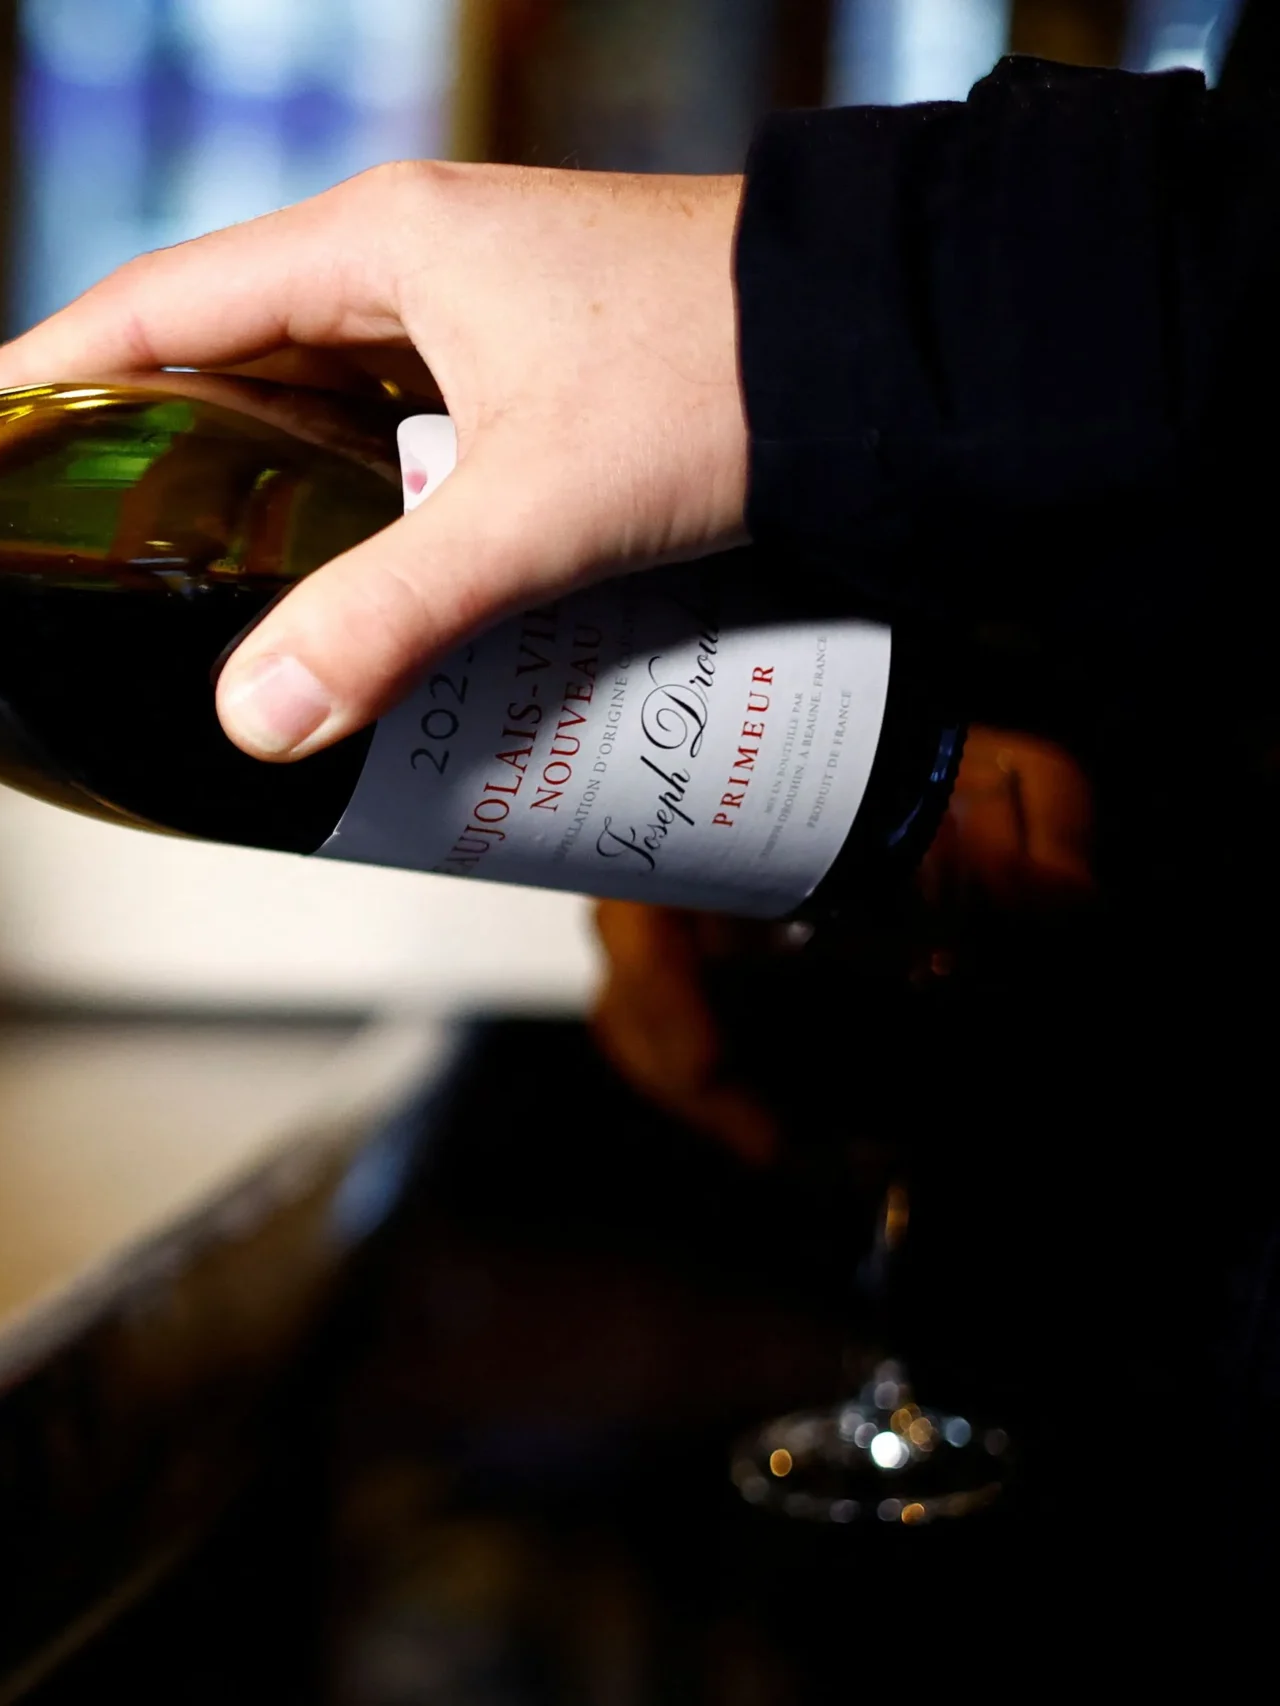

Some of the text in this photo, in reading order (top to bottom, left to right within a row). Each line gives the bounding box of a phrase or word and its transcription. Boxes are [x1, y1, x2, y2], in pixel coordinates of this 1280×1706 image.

[410, 643, 474, 775] 202
[530, 623, 603, 812] NOUVEAU
[814, 636, 827, 687] FRANCE
[592, 676, 628, 774] D'ORIGINE
[711, 665, 775, 828] PRIMEUR
[777, 717, 799, 777] BOUTEILLE
[791, 691, 804, 713] PAR
[806, 690, 852, 829] PRODUIT DE FRANCE
[596, 755, 691, 872] Joseph
